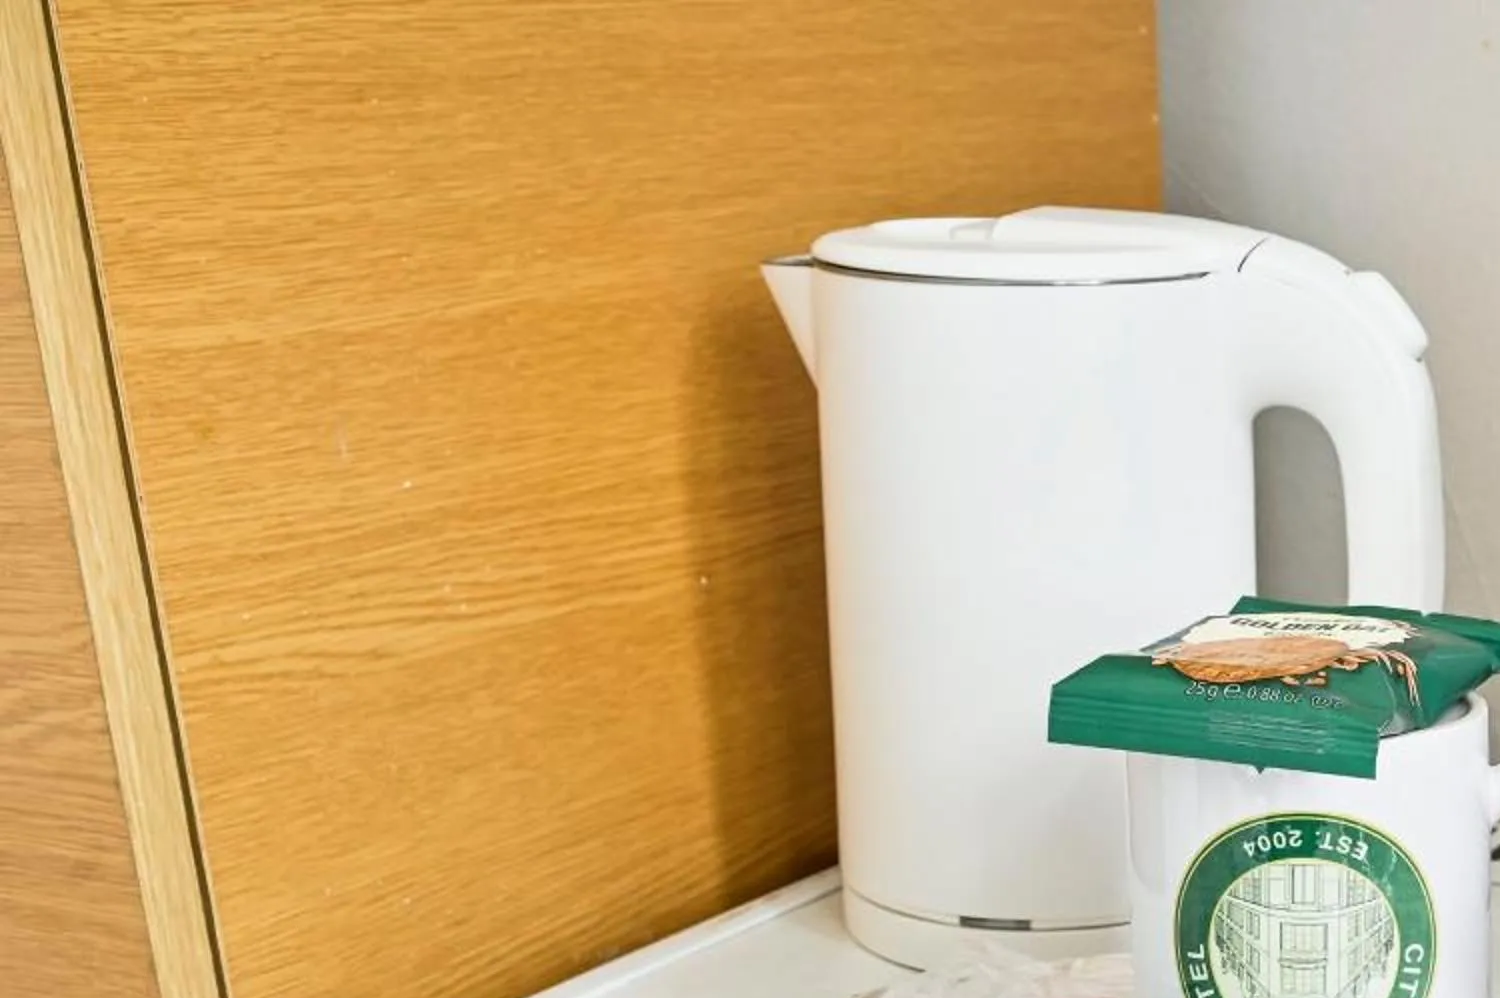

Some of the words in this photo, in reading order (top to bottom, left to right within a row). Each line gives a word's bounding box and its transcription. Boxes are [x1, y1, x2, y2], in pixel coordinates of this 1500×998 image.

[1230, 616, 1338, 632] GOLDEN
[1243, 829, 1303, 858] 2004
[1315, 830, 1369, 860] EST.
